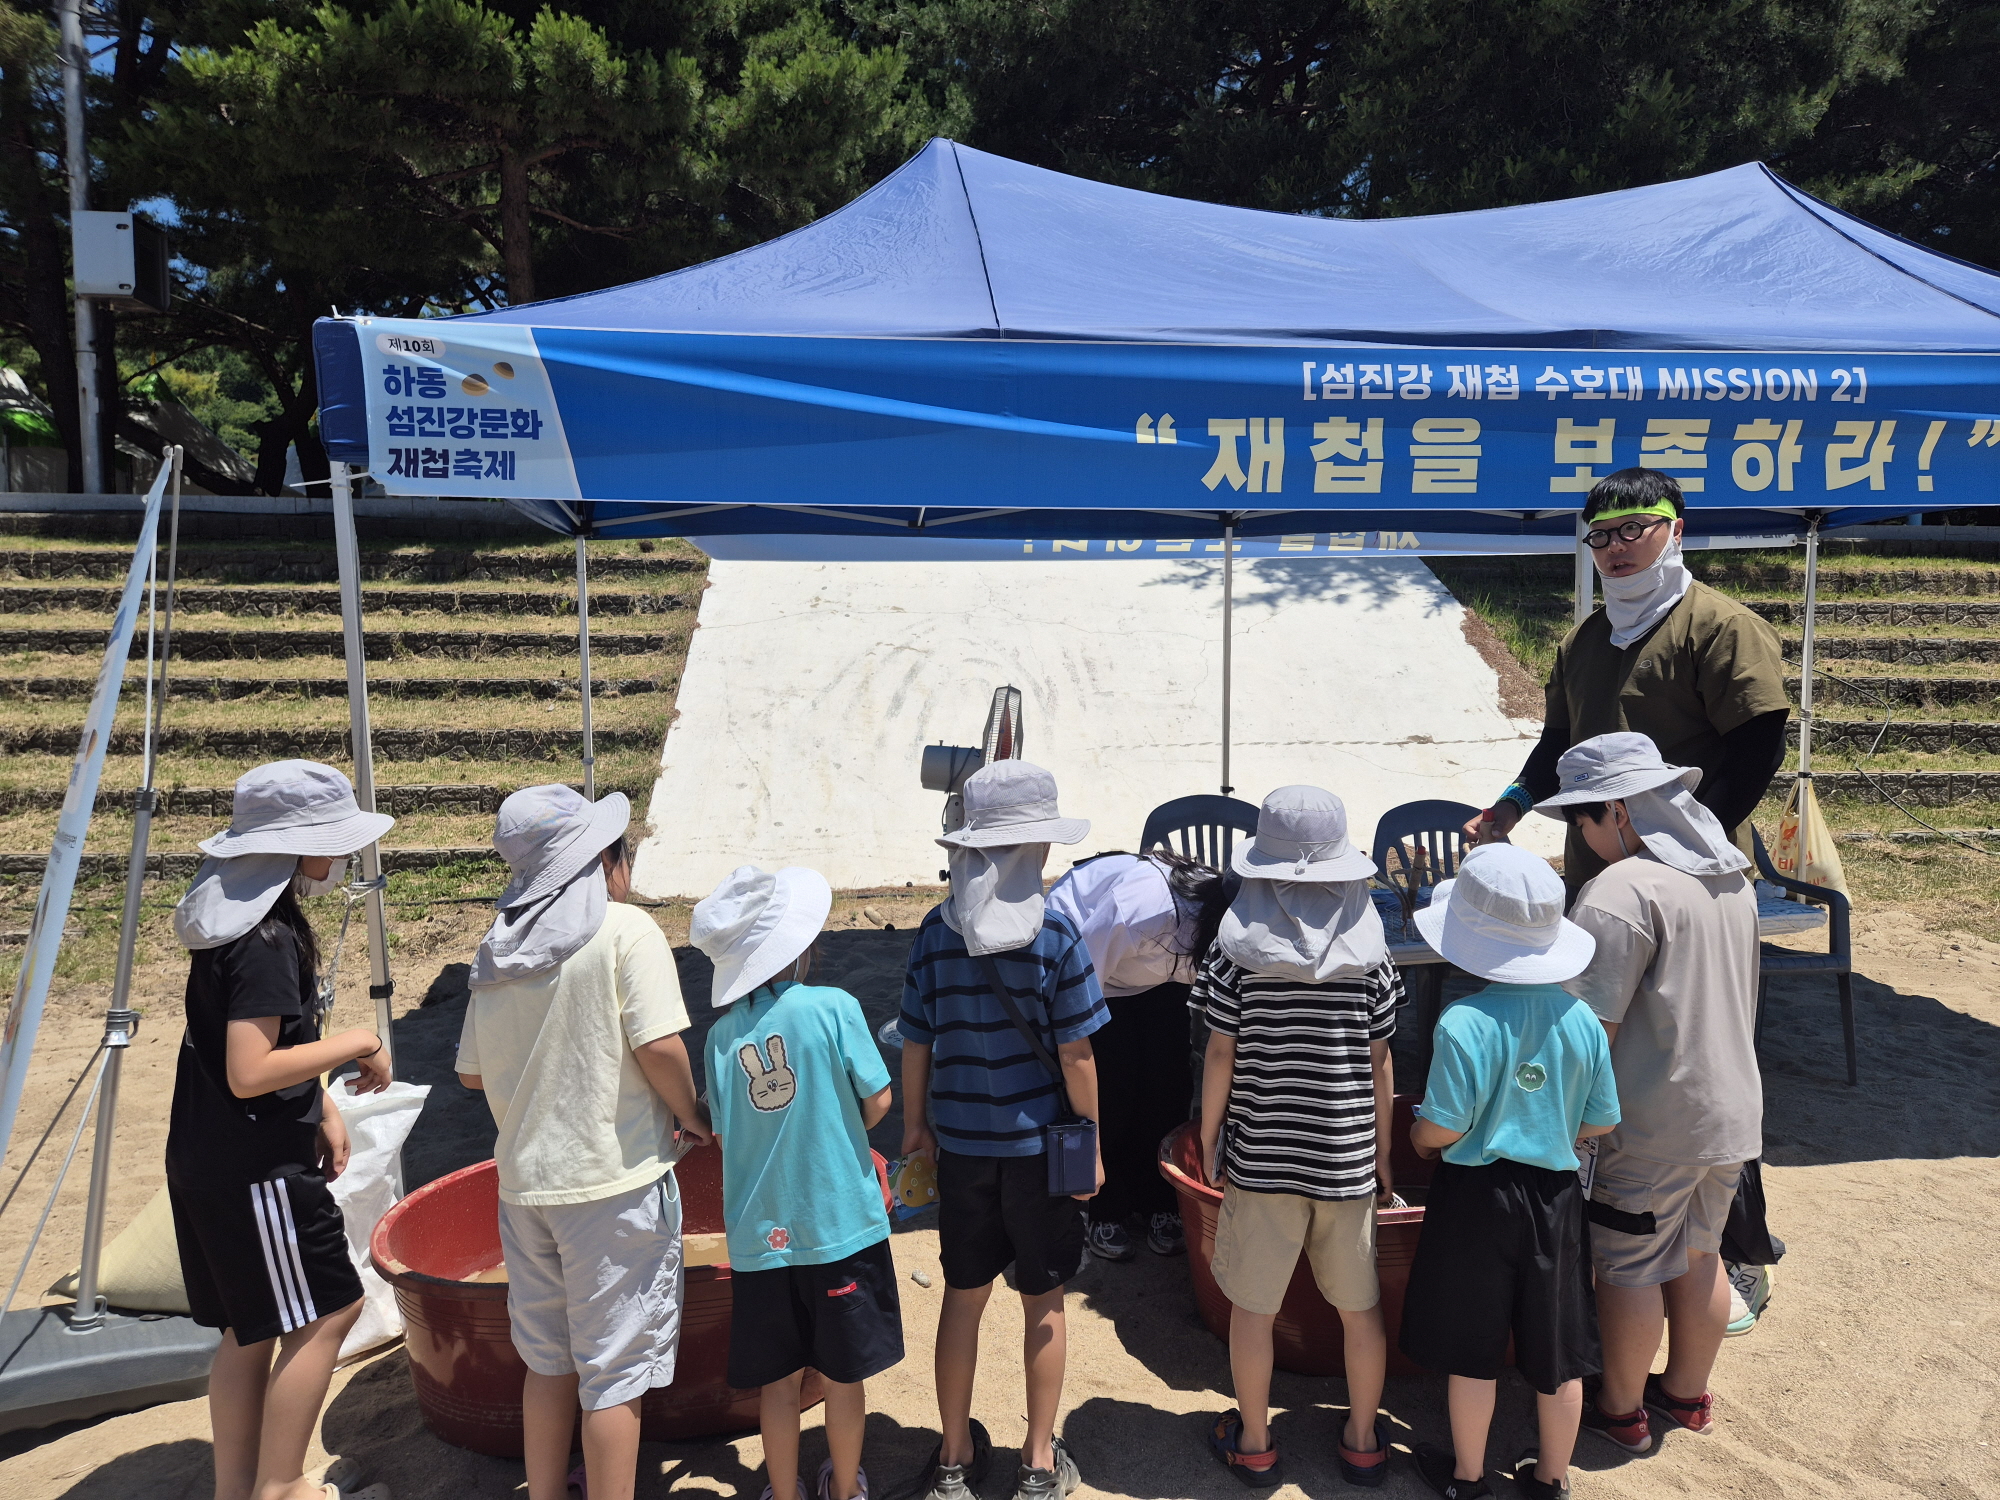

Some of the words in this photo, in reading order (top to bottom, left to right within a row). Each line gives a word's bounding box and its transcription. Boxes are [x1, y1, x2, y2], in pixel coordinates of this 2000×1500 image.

[387, 337, 435, 354] 제10회
[383, 364, 447, 399] 하동
[1303, 361, 1433, 401] [섬진강
[1446, 364, 1520, 401] 재첩
[1535, 365, 1643, 401] 수호대
[1657, 367, 1818, 402] MISSION
[1830, 367, 1867, 404] 2]
[385, 405, 543, 440] 섬진강문화
[386, 447, 516, 481] 재첩축제
